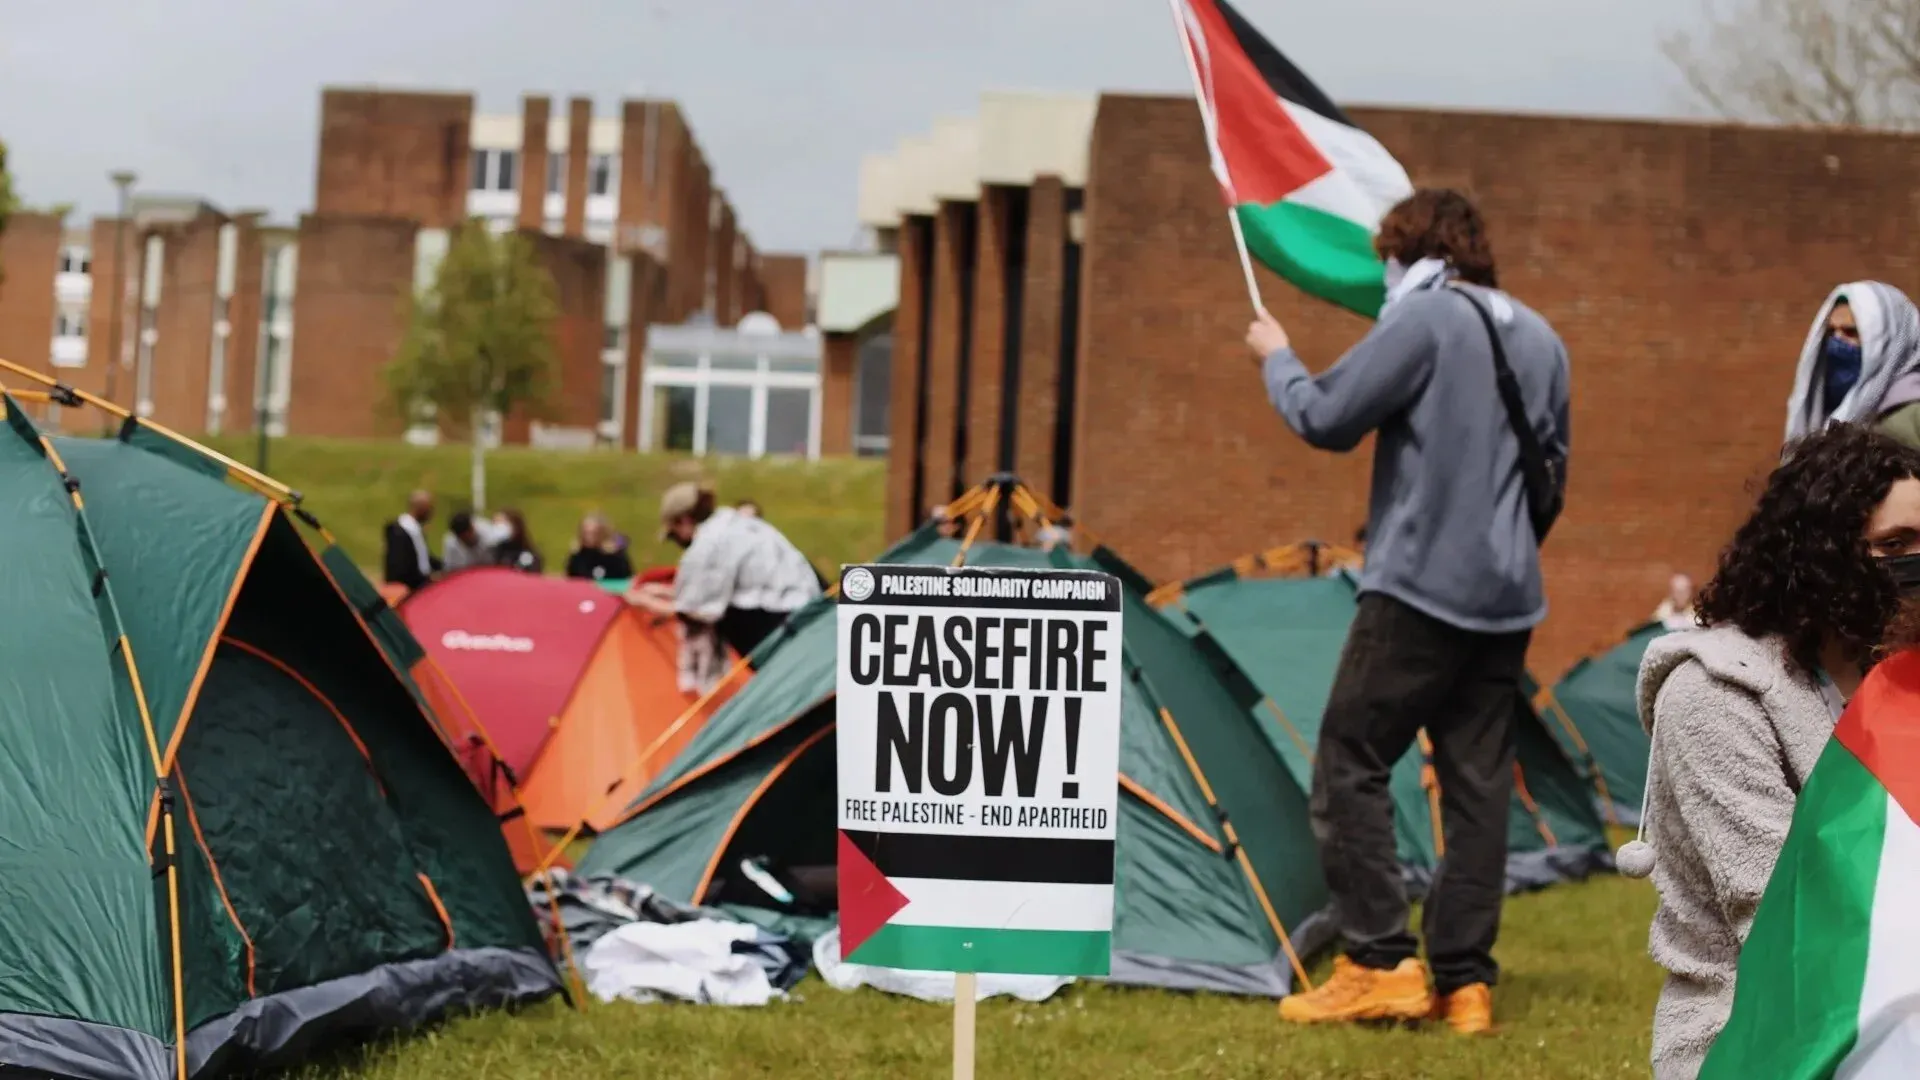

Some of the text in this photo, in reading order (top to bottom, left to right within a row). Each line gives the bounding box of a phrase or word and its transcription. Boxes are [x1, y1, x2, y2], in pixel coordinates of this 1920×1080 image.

[881, 575, 951, 597] PALESTINE
[952, 577, 1031, 600] SOLIDARITY
[1031, 580, 1106, 600] CAMPAIGN
[850, 613, 1107, 692] CEASEFIRE
[845, 799, 877, 821] FREE
[882, 801, 964, 825] PALESTINE
[982, 805, 1012, 826] END
[1017, 806, 1107, 829] APARTHEID
